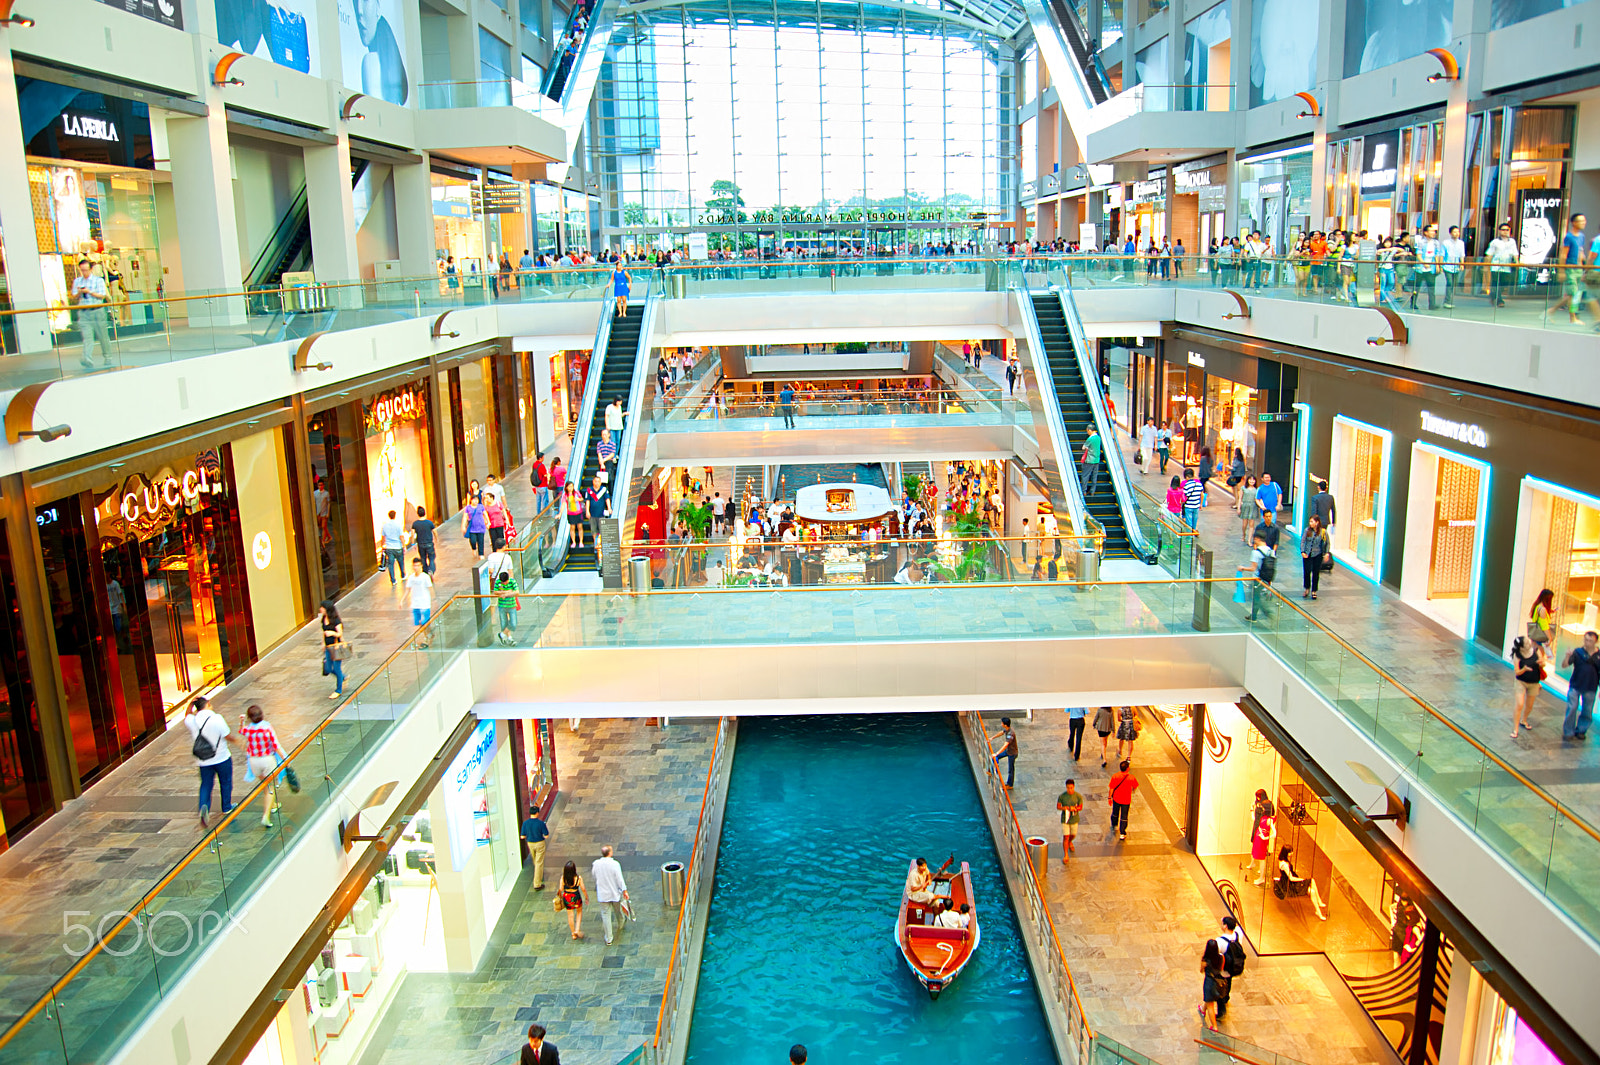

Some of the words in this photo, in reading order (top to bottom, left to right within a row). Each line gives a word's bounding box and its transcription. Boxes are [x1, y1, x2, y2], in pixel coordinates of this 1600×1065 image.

[62, 113, 83, 136] LA
[80, 116, 120, 142] PERLA
[1524, 198, 1562, 208] HUBLOT
[376, 391, 414, 423] GUCCI
[464, 422, 486, 446] GUCCI
[121, 466, 209, 522] GUCCI
[456, 729, 493, 793] Samsonite
